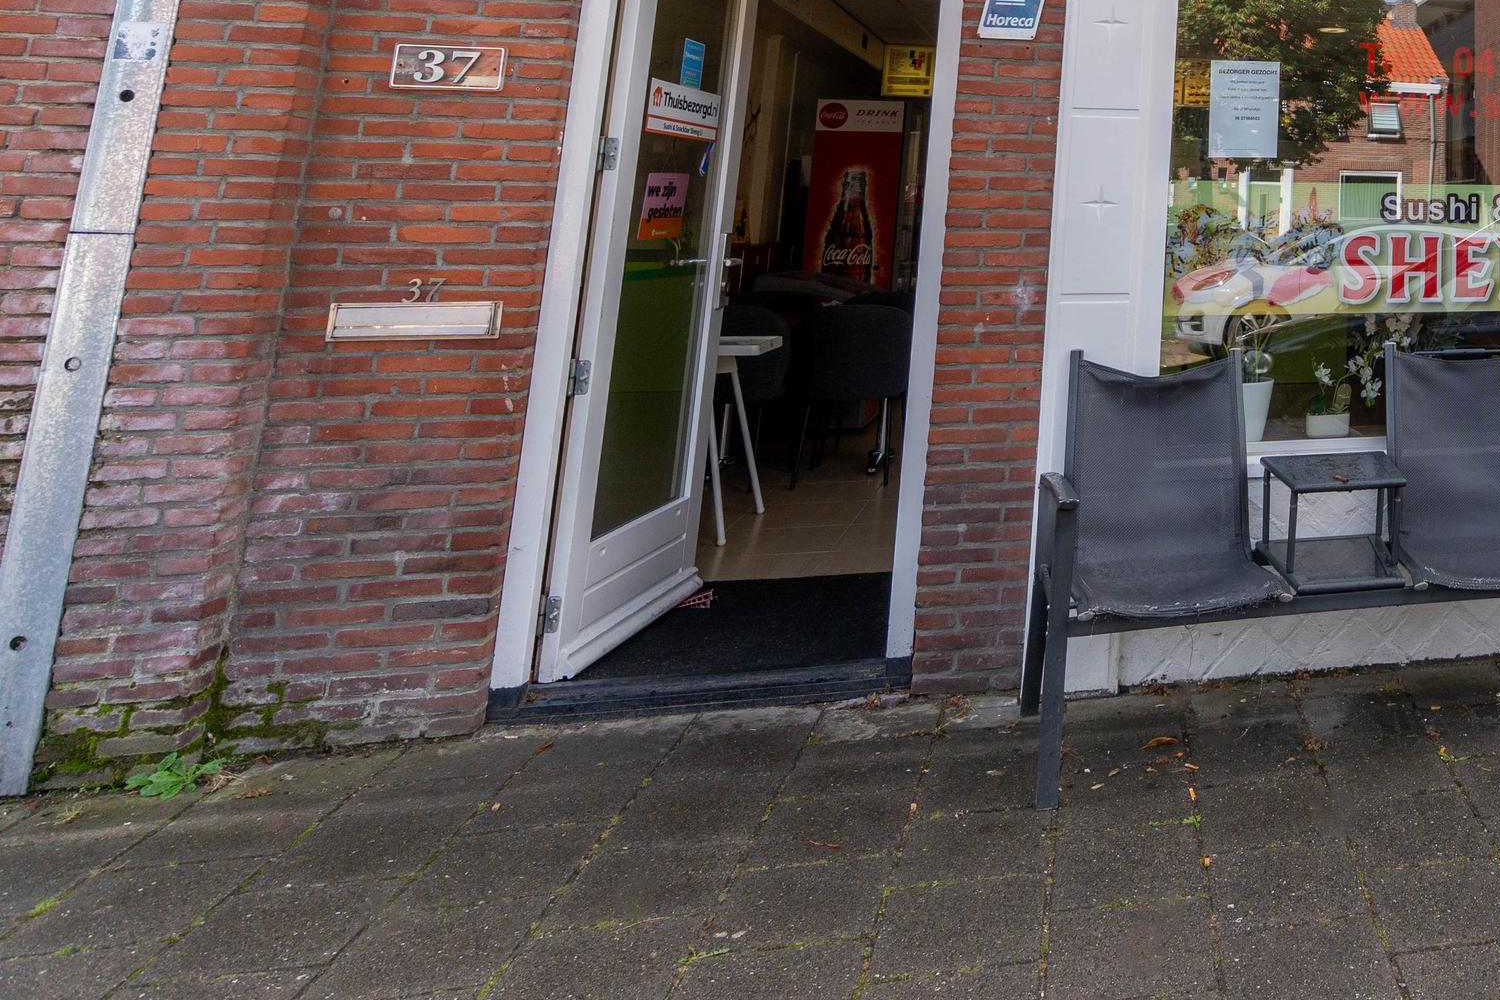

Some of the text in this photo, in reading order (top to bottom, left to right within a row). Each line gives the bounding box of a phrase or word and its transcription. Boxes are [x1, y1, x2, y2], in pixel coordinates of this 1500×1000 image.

[986, 13, 1034, 28] Horeca
[413, 50, 481, 84] 37
[664, 91, 719, 119] Thuisbezorgd.nl
[856, 109, 899, 118] DRINK
[648, 182, 677, 200] we zijn
[647, 203, 682, 222] gesloten
[1382, 194, 1478, 222] Sushi
[401, 277, 447, 303] 37
